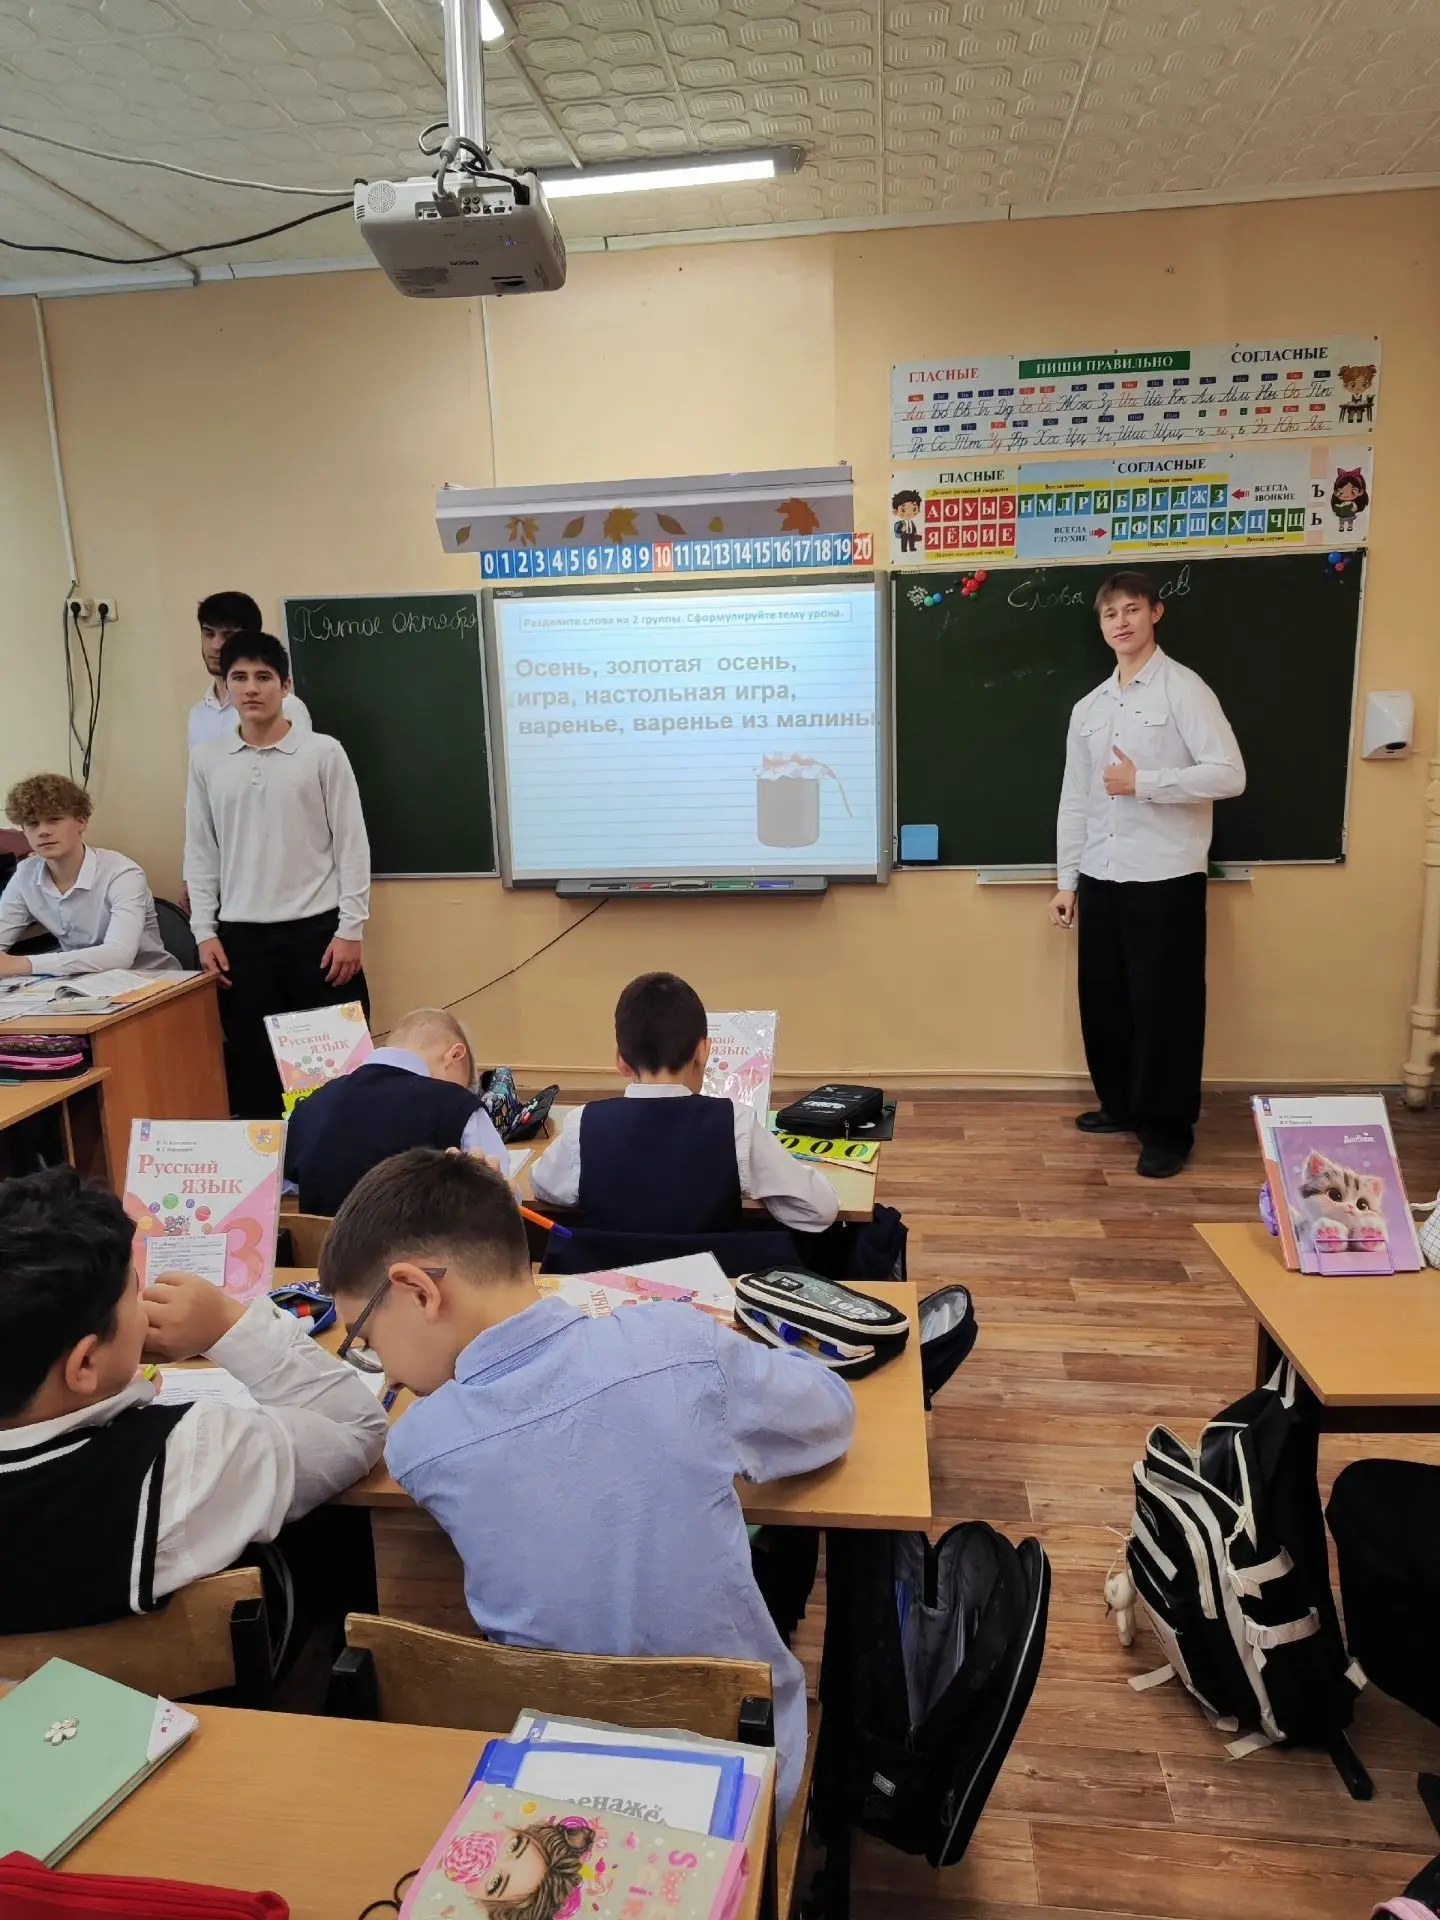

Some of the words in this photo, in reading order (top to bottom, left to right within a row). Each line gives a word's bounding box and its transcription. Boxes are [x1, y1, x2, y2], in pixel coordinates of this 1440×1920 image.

[1036, 361, 1082, 375] ПИШИ
[1087, 355, 1174, 372] ПРАВИЛЬНО
[1231, 347, 1328, 364] СОГЛАСНЫЕ
[909, 368, 980, 383] ГЛАСНЫЕ
[1118, 458, 1207, 474] СОГЛАСНЫЕ
[939, 469, 1005, 484] ГЛАСНЫЕ
[1255, 484, 1288, 494] ВСЕГДА
[1255, 492, 1295, 502] ЗВОНКИЕ
[1312, 484, 1325, 498] Ъ
[927, 506, 940, 518] А
[944, 504, 958, 517] О
[964, 502, 977, 517] У
[981, 502, 996, 515] Ы
[1002, 501, 1013, 514] Э
[1020, 500, 1032, 512] Н
[1038, 499, 1052, 512] М
[1056, 498, 1069, 512] Л
[1079, 498, 1089, 511] Р
[1096, 491, 1108, 509] Й
[1116, 494, 1128, 507] Б
[1135, 493, 1147, 506] В
[1155, 492, 1166, 506] Г
[1173, 491, 1187, 507] Д
[1191, 490, 1207, 504] Ж
[1215, 489, 1225, 503] З
[1114, 522, 1127, 535] П
[1132, 521, 1148, 535] Ф
[1152, 520, 1165, 534] К
[1173, 519, 1185, 533] Т
[1190, 517, 1206, 531] Ш
[1211, 516, 1224, 531] С
[1230, 515, 1244, 529] Х
[1249, 514, 1263, 531] Ц
[1270, 513, 1283, 528] Ч
[1288, 513, 1304, 529] Щ
[1311, 512, 1323, 526] Ь
[927, 531, 940, 545] Я
[946, 527, 958, 544] Ё
[963, 529, 977, 543] Ю
[983, 528, 996, 542] И
[1003, 527, 1013, 542] Е
[1054, 526, 1087, 534] ВСЕГДА
[485, 554, 494, 574] 0
[502, 554, 510, 573] 1
[518, 553, 529, 573] 2
[536, 553, 546, 572] 3
[552, 552, 563, 571] 4
[570, 551, 580, 571] 5
[587, 550, 598, 570] 6
[605, 549, 615, 569] 7
[622, 548, 632, 568] 8
[639, 548, 649, 568] 9
[655, 547, 671, 567] 10
[676, 546, 690, 566] 11
[694, 545, 711, 565] 12
[714, 545, 730, 564] 13
[735, 544, 751, 564] 14
[755, 543, 771, 563] 15
[774, 543, 791, 562] 16
[794, 542, 810, 561] 17
[814, 540, 831, 561] 18
[833, 539, 851, 560] 19
[853, 537, 873, 560] 20
[292, 602, 383, 643] Пятое
[524, 616, 581, 628] Разделите
[583, 616, 613, 626] слова
[617, 615, 629, 625] на
[633, 614, 640, 624] 2
[687, 609, 776, 624] Сформулируйте
[778, 610, 805, 620] тему
[807, 609, 844, 621] урока.
[516, 658, 598, 679] Осень,
[606, 655, 701, 675] золотая
[717, 653, 797, 674] осень,
[518, 687, 577, 711] игра,
[585, 683, 726, 704] настольная
[735, 681, 796, 705] игра,
[518, 714, 624, 737] варенье,
[633, 712, 734, 734] варенье
[743, 710, 768, 728] из
[137, 1154, 219, 1177] Русский
[222, 1217, 264, 1294] 3
